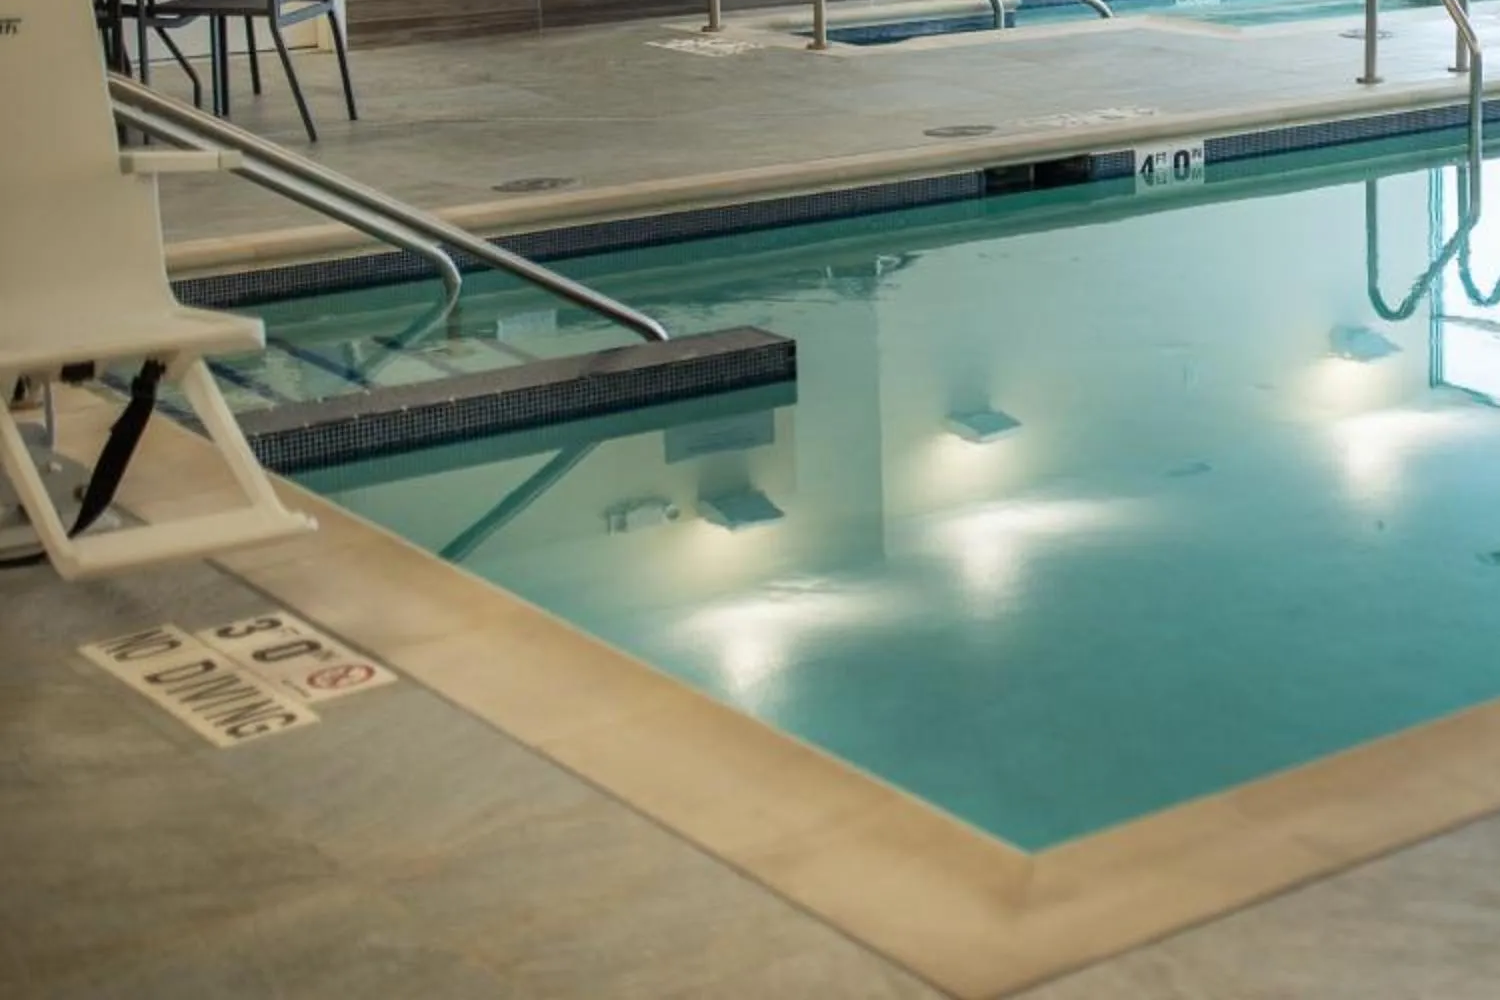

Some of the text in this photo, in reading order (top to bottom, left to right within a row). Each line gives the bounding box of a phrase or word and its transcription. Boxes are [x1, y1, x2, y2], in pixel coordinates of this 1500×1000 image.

[216, 616, 283, 640] 3
[251, 639, 323, 664] 0
[99, 628, 297, 740] NO DIVING
